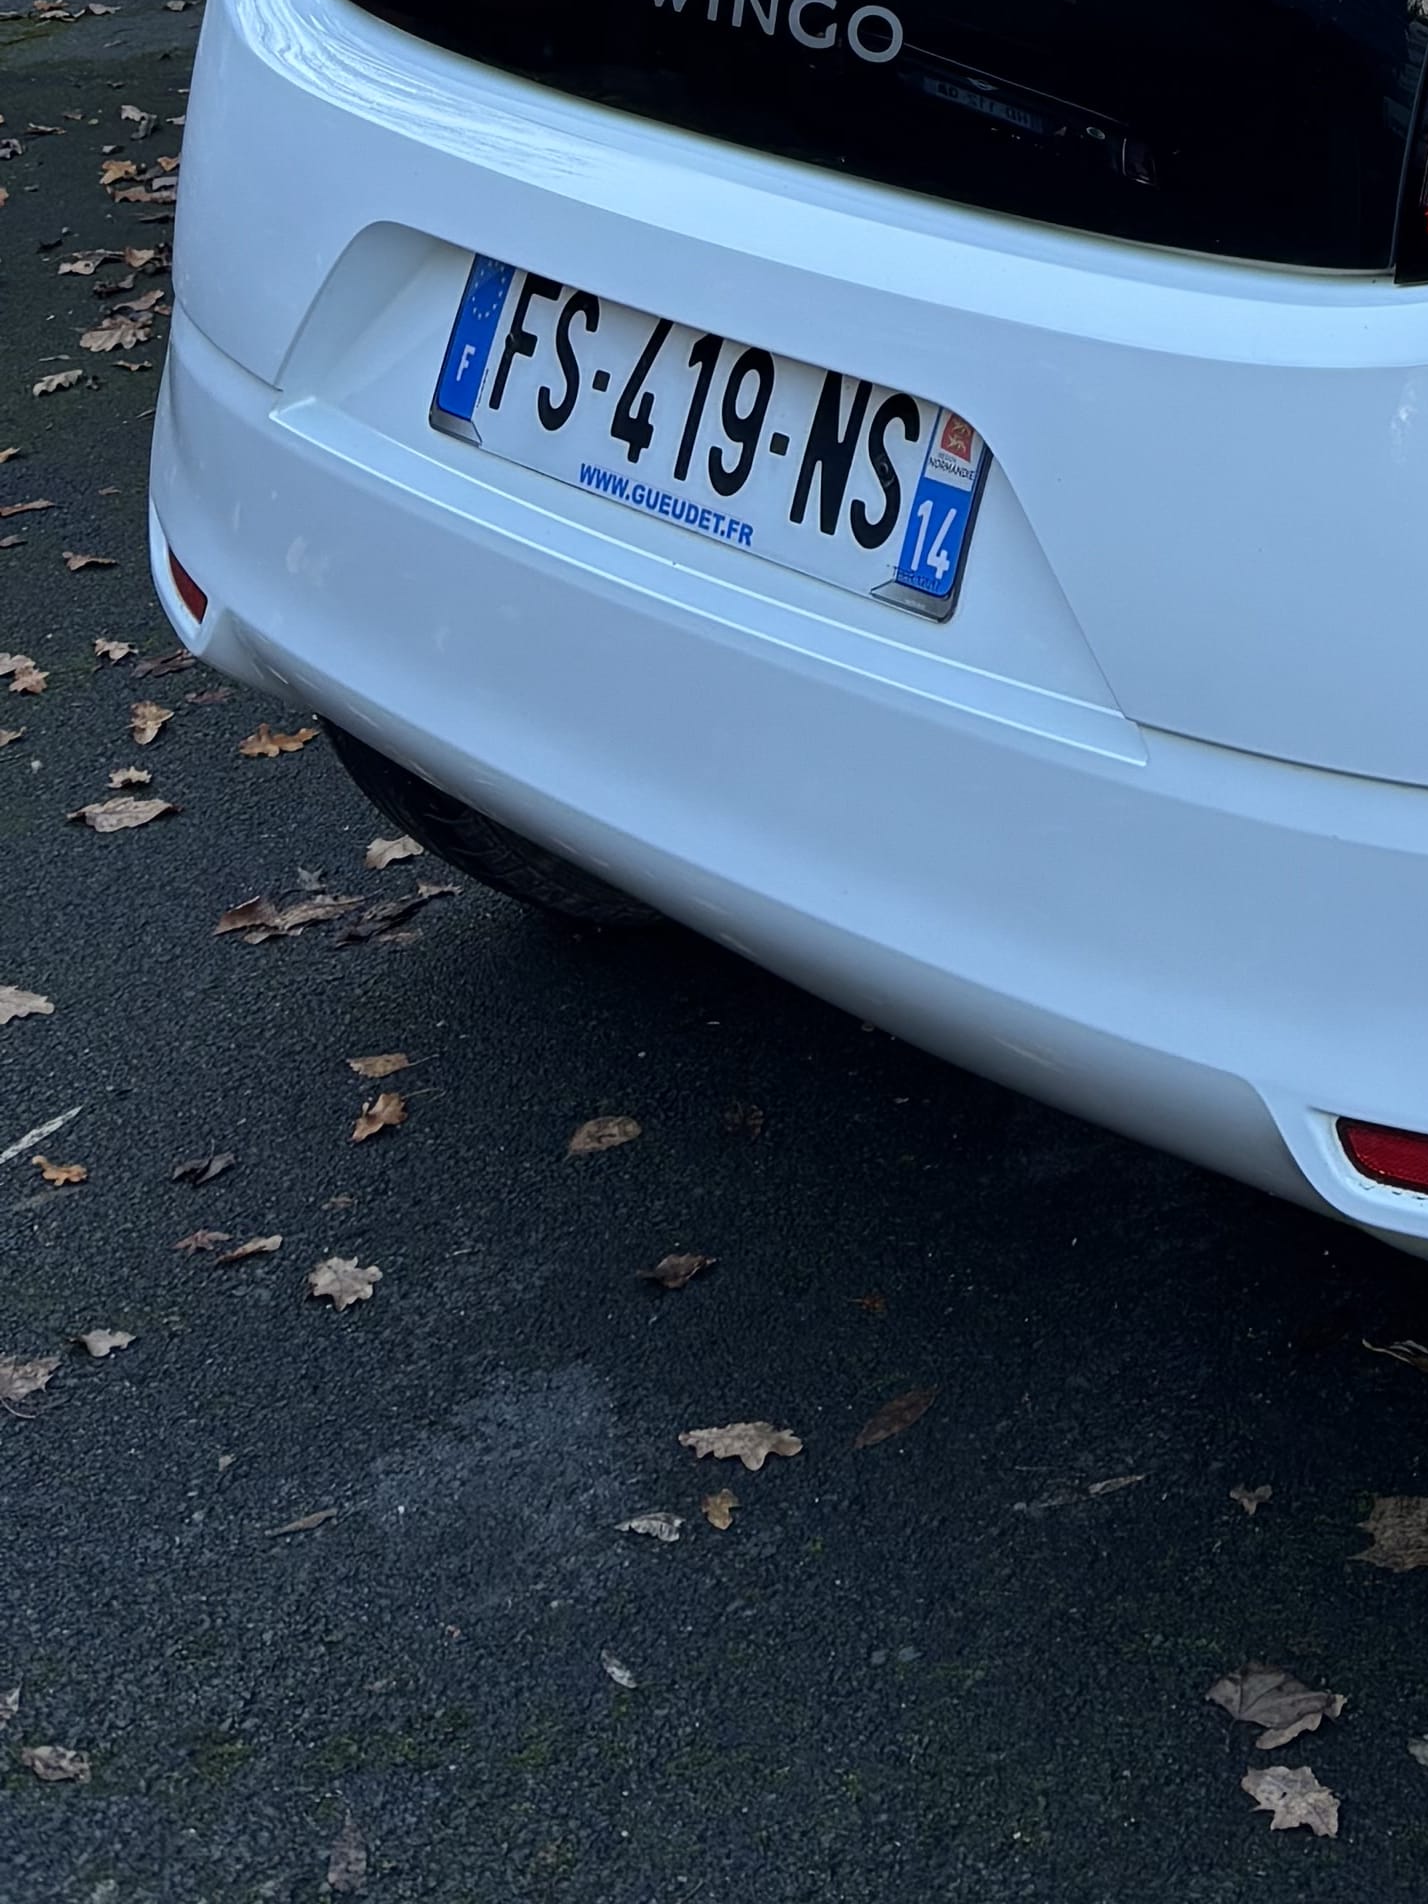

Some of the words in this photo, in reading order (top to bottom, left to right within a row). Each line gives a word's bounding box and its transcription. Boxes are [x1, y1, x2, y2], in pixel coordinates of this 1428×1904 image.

[455, 345, 477, 383] F
[489, 271, 921, 550] FS-419-NS
[578, 462, 754, 547] WWW.GUEUDET.FR
[929, 456, 976, 481] NORMANDIE
[912, 499, 958, 580] 14
